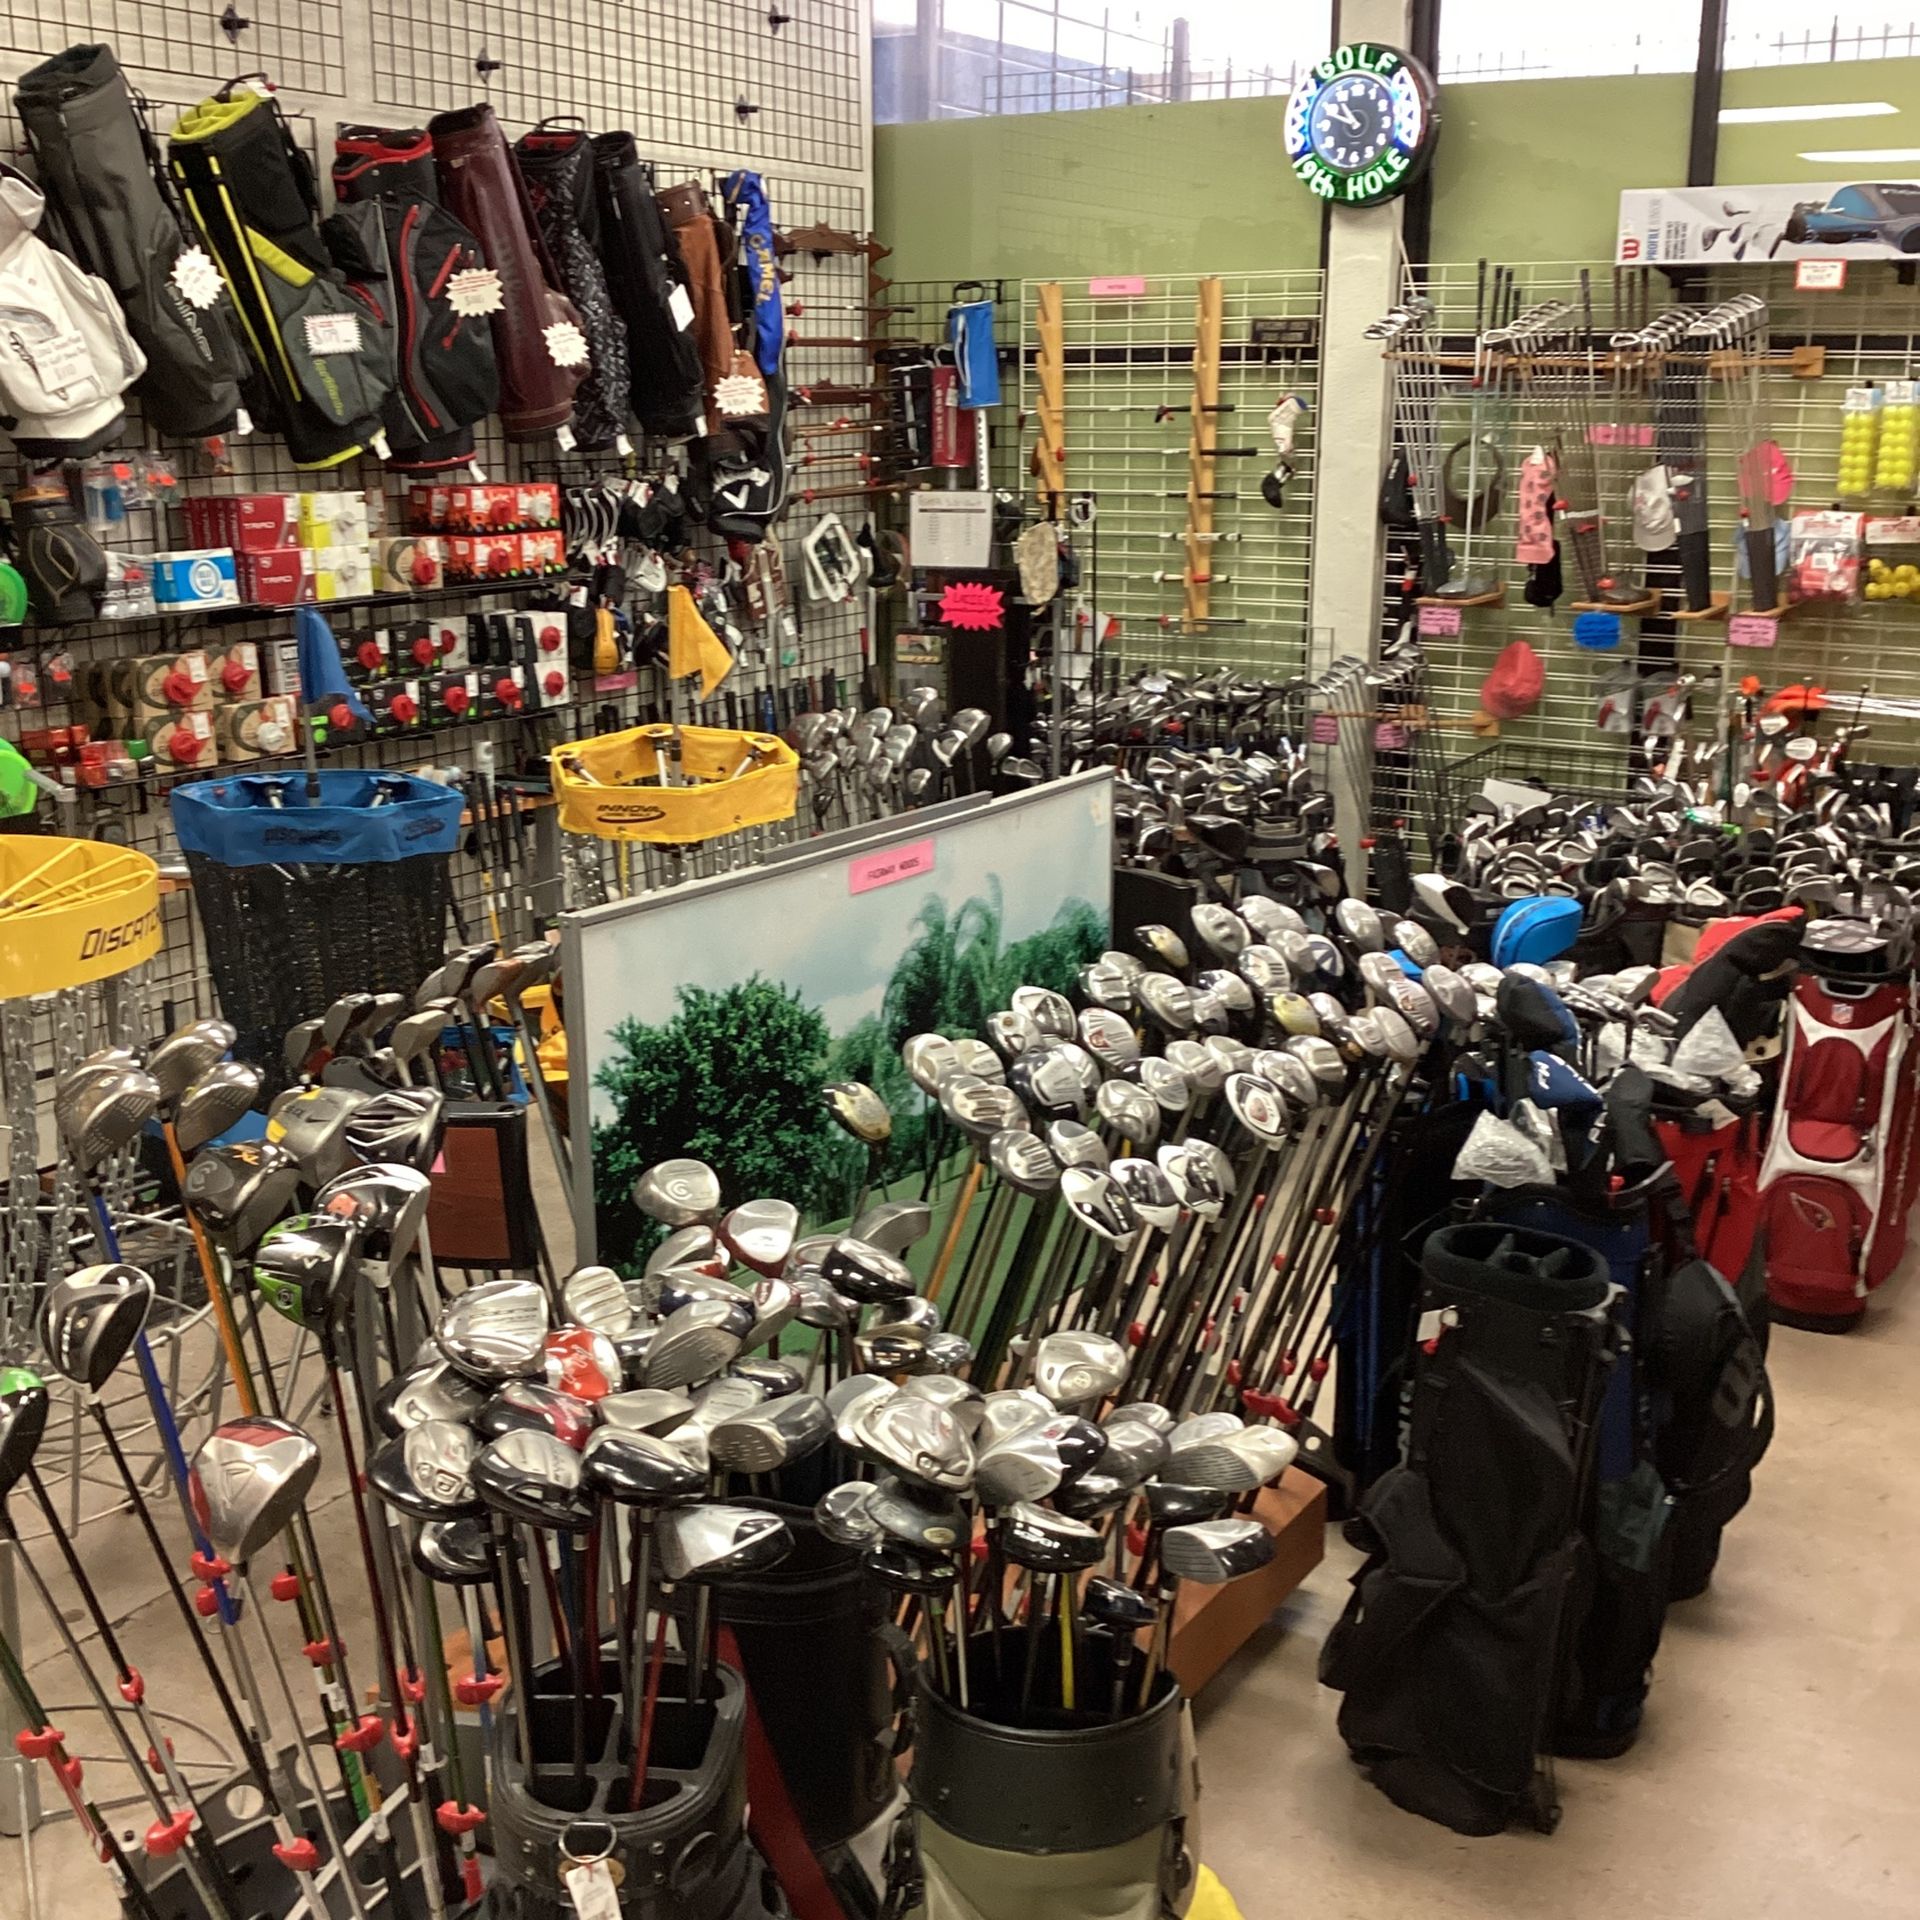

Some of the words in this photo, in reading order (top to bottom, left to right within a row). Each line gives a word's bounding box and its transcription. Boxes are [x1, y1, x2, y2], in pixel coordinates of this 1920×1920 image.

[1316, 44, 1398, 79] GOLF
[1381, 116, 1391, 129] 3
[1349, 151, 1360, 163] 6
[1292, 153, 1335, 198] 19th
[1347, 148, 1410, 200] HOLE
[597, 804, 660, 812] INNOVA
